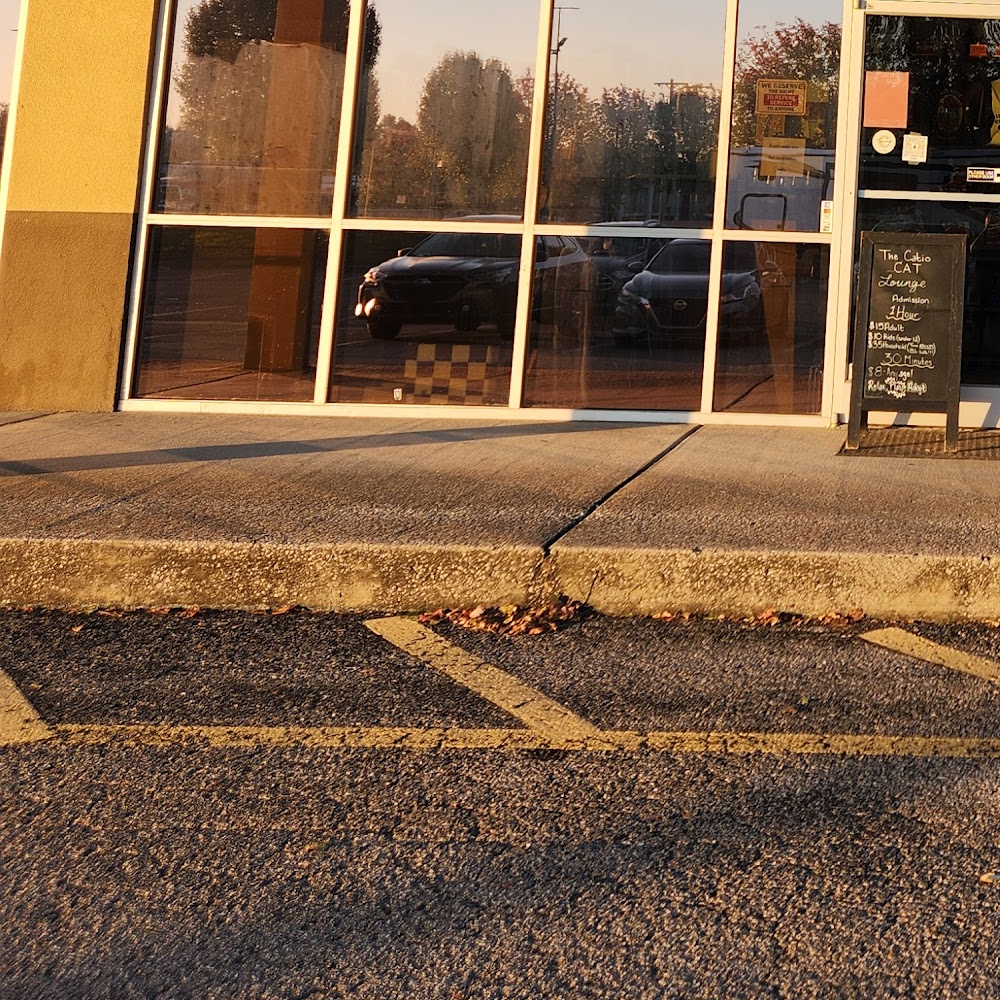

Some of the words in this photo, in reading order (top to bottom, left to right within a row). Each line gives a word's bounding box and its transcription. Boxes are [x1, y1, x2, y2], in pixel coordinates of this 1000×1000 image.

[878, 249, 899, 261] The
[903, 249, 932, 263] Catio
[893, 261, 922, 275] CAT
[878, 274, 927, 293] Lounge
[892, 294, 930, 304] Admission
[896, 305, 920, 319] Hour
[883, 353, 902, 364] 30
[904, 355, 933, 366] Minutes
